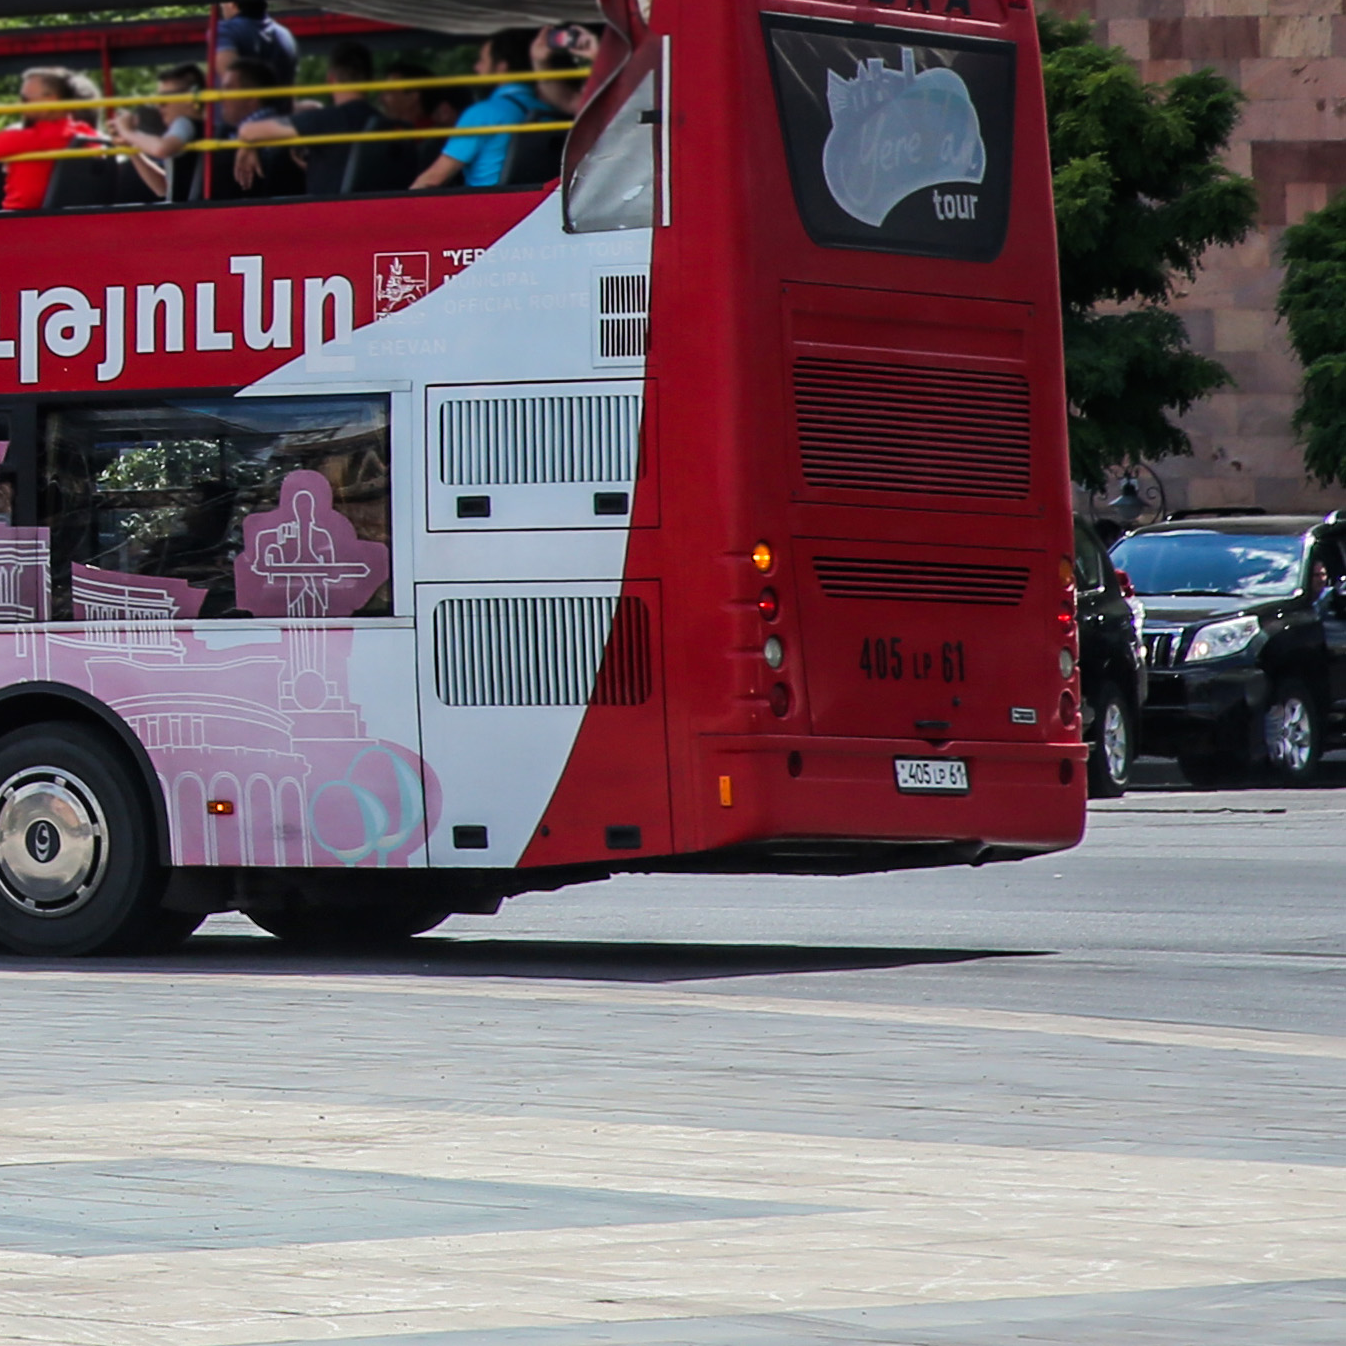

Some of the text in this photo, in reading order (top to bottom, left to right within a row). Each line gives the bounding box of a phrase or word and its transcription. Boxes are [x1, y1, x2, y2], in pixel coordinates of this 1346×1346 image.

[932, 189, 979, 221] tour
[859, 637, 965, 683] 405 LP 61
[909, 763, 965, 785] 405 LP 61
